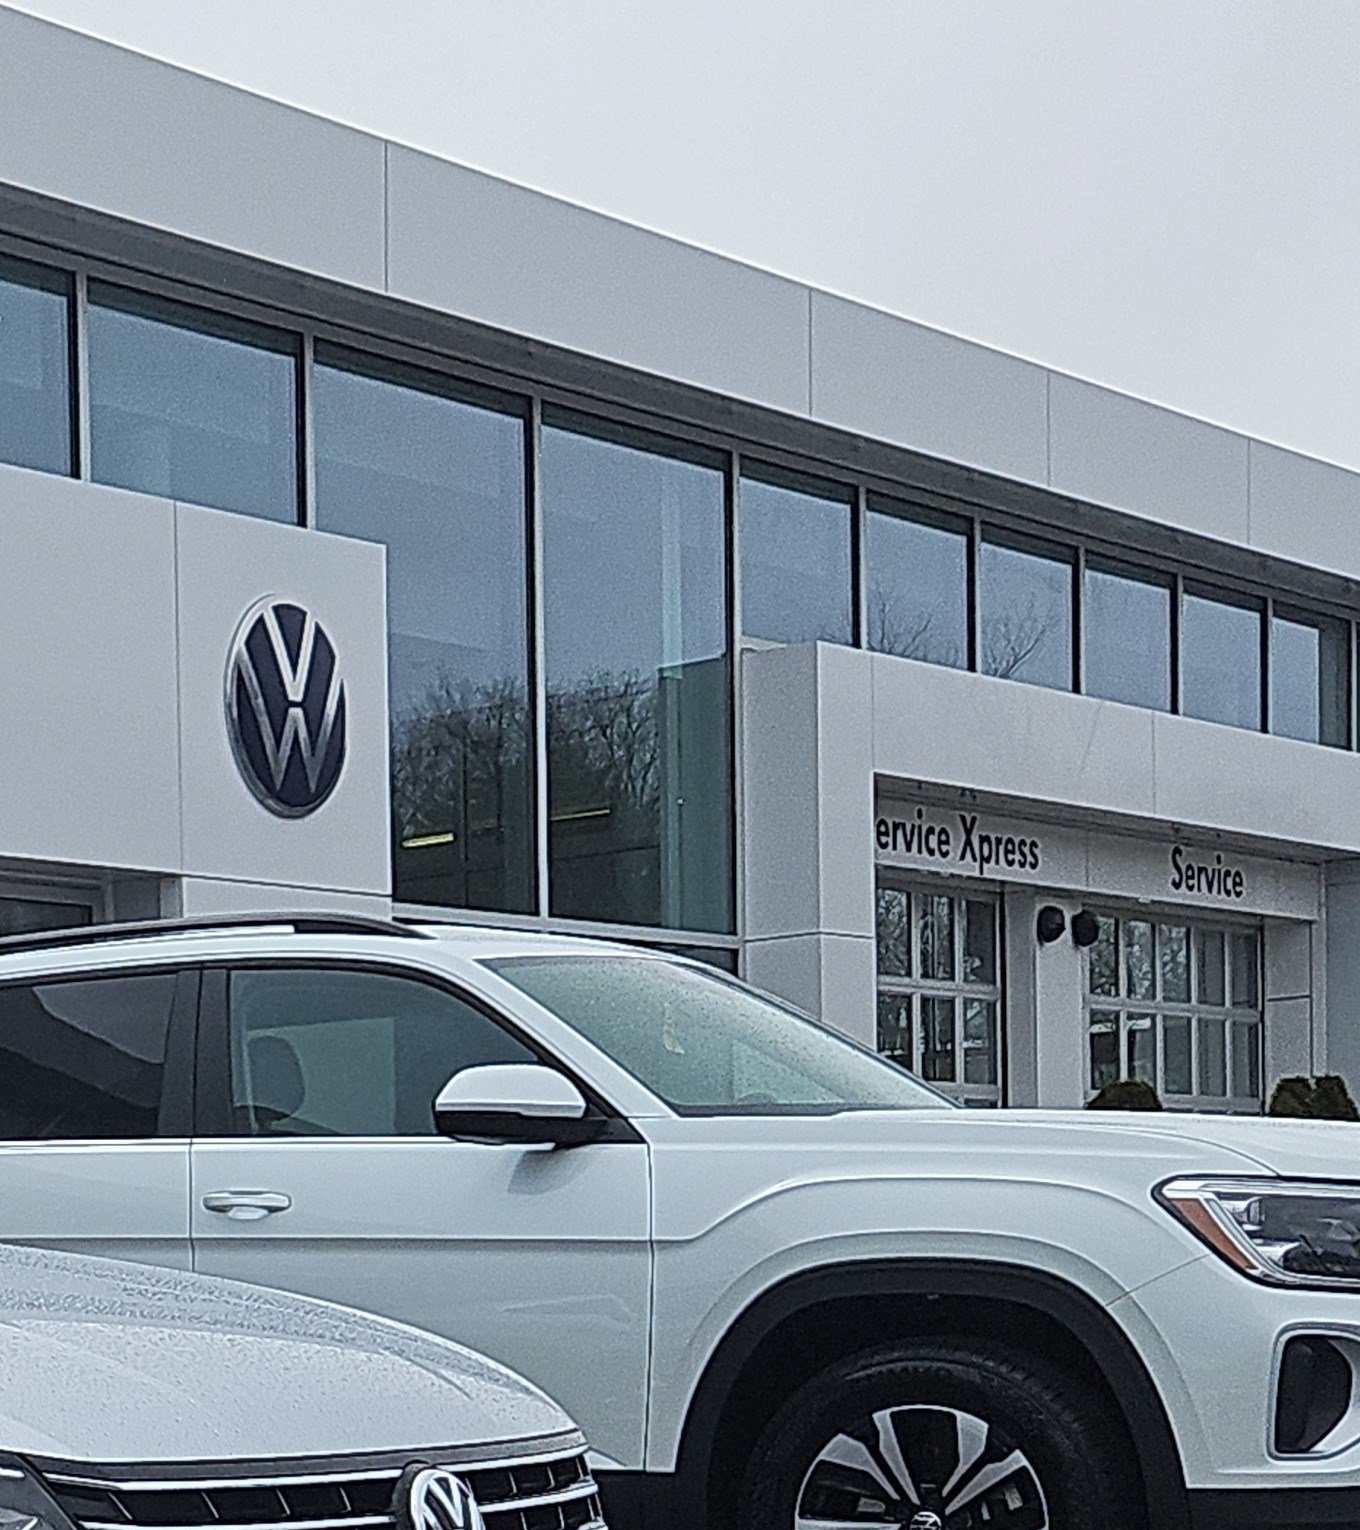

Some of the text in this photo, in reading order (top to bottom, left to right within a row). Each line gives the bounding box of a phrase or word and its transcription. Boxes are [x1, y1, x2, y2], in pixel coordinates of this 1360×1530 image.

[875, 807, 1040, 876] ervice Xpress
[1170, 845, 1244, 899] Service
